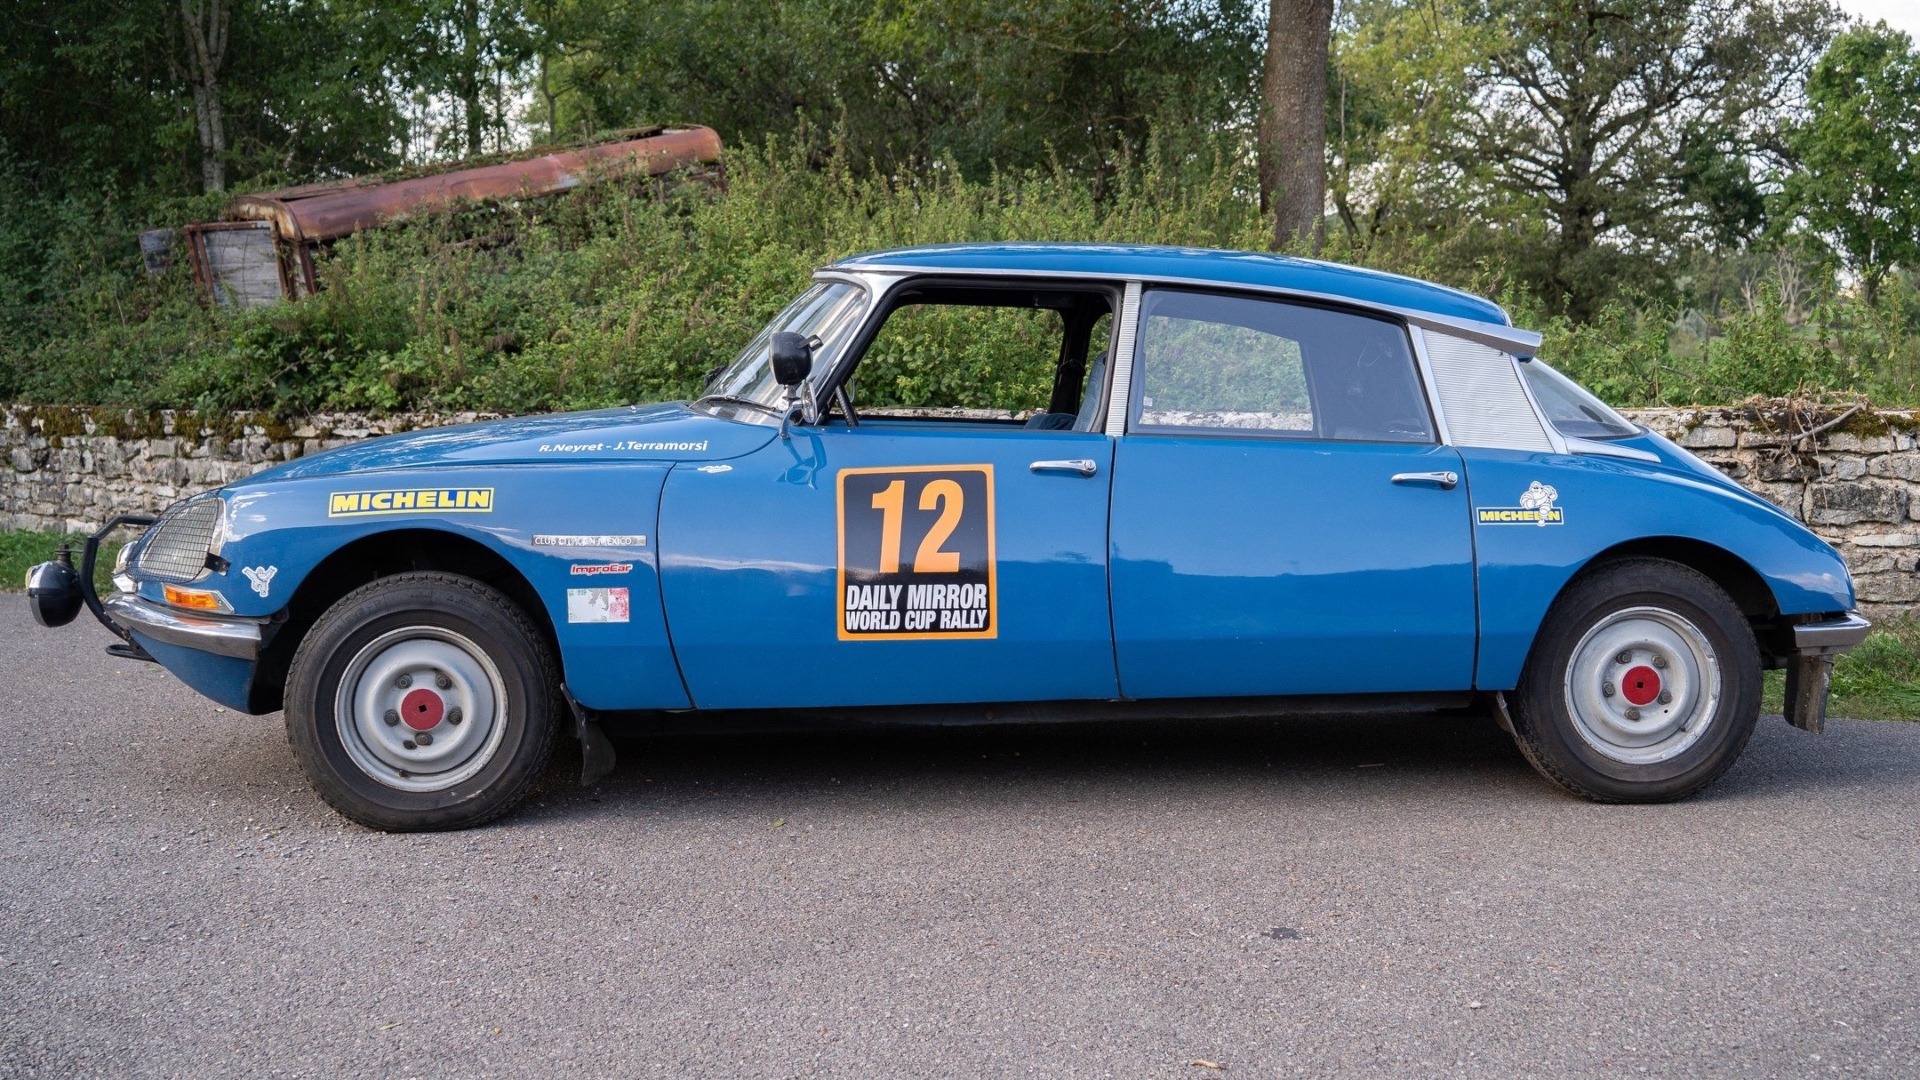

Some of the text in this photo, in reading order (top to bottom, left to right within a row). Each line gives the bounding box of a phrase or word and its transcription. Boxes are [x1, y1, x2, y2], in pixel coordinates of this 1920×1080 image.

[539, 442, 603, 453] R.Neyret
[614, 440, 708, 451] J.Terramorsi
[332, 490, 490, 513] MICHELIN
[871, 479, 964, 573] 12
[1480, 510, 1560, 521] MICHELN
[534, 536, 556, 546] CLUB
[846, 583, 987, 610] DAILY MIRROR
[845, 609, 988, 630] WORLD CUP RALLY
